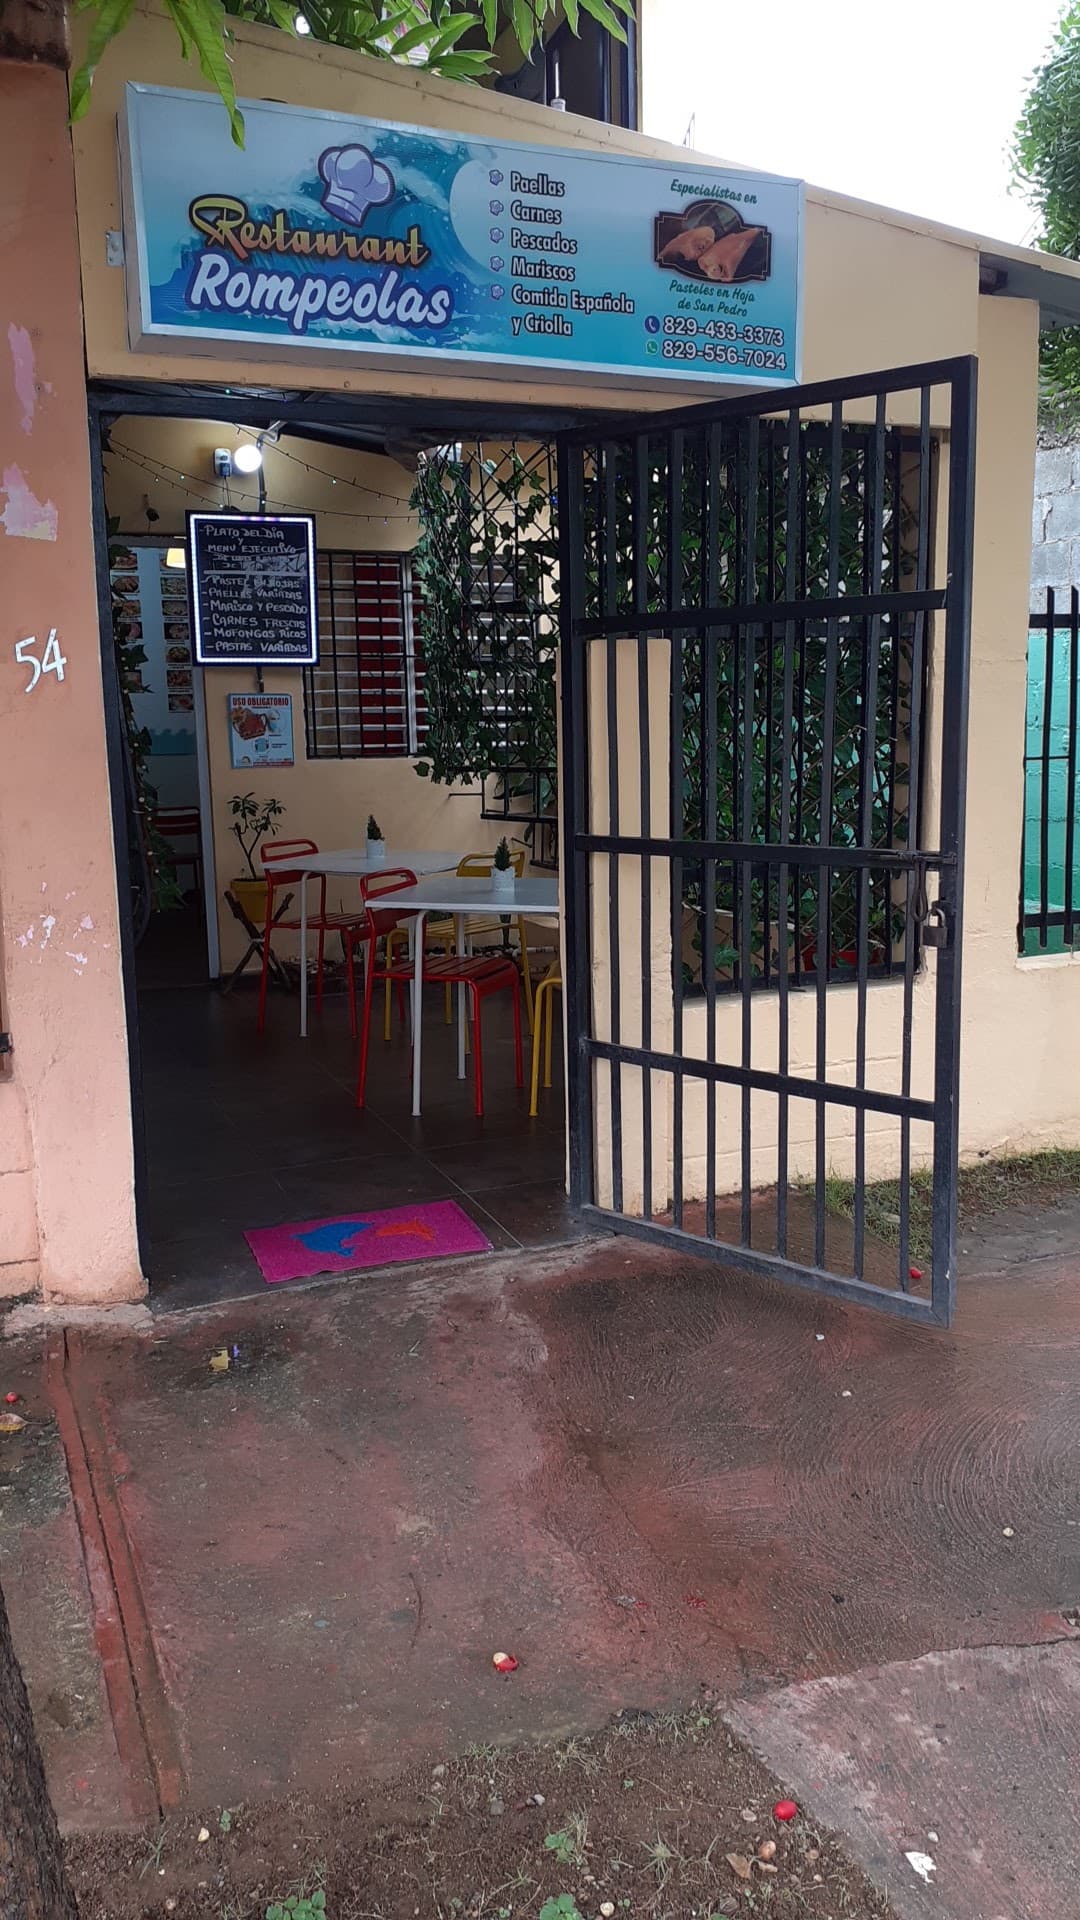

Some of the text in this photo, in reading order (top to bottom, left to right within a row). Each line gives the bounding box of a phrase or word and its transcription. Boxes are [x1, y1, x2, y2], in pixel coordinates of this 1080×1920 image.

[511, 171, 565, 197] Paellas
[670, 179, 758, 205] Especialistas en
[511, 200, 562, 224] Carnes
[190, 195, 429, 266] Restaurant
[511, 227, 577, 254] Pescados
[511, 256, 575, 281] Mariscos
[189, 252, 451, 331] Rompeolas
[511, 283, 635, 314] Comida Española
[669, 280, 756, 303] Pasteles en Hoja
[677, 298, 748, 318] de San Pedro
[512, 312, 573, 336] y Criolla
[663, 315, 785, 346] 829-433-3373
[662, 339, 787, 370] 829-556-7024
[204, 524, 239, 537] PLATO
[212, 613, 258, 627] CARNES
[15, 629, 67, 693] 54
[247, 697, 289, 706] OBLIGATORIO
